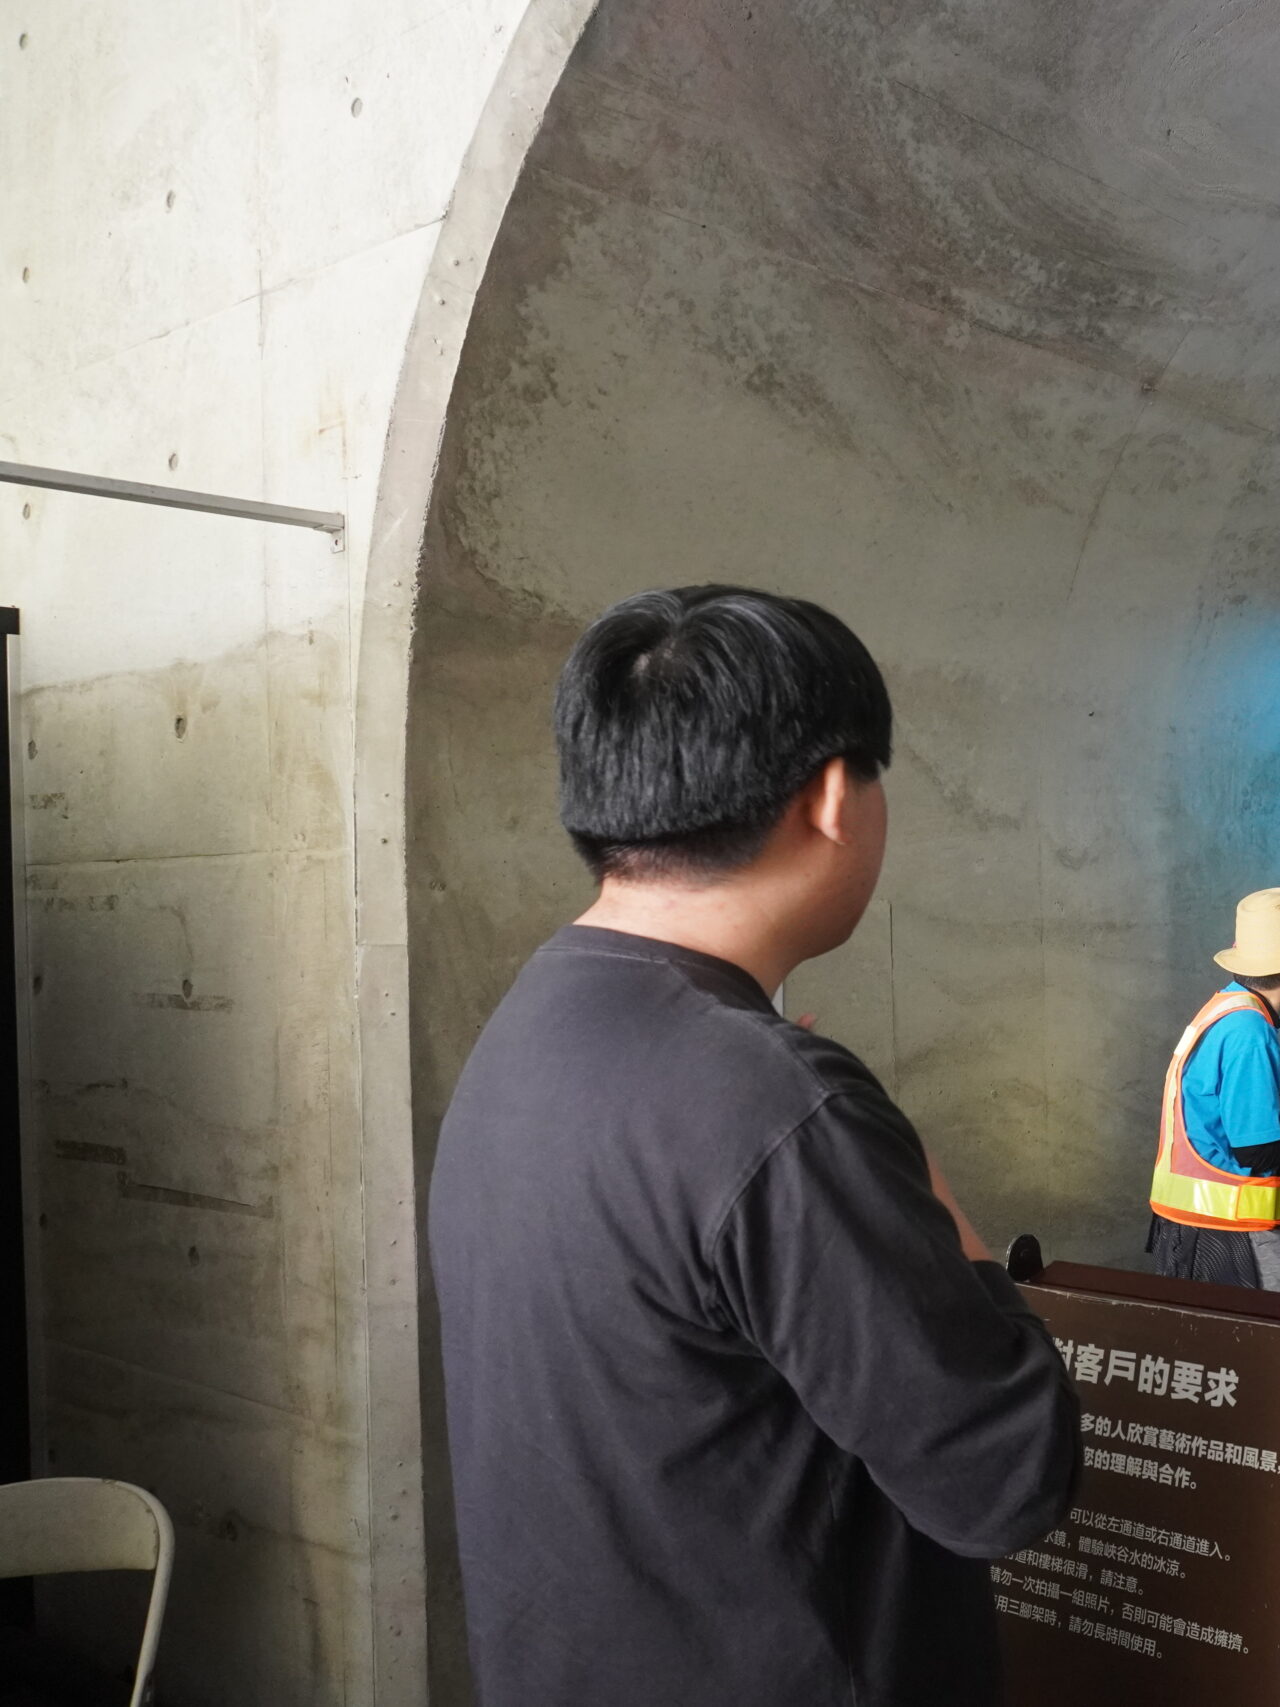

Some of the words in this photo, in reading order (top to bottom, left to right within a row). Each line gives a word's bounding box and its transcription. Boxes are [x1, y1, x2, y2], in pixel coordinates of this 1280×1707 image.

[1004, 1548, 1145, 1596] 道和樓梯很滑，請注意。
[994, 1594, 1163, 1660] 用三腳架時，請勿長時間使用。
